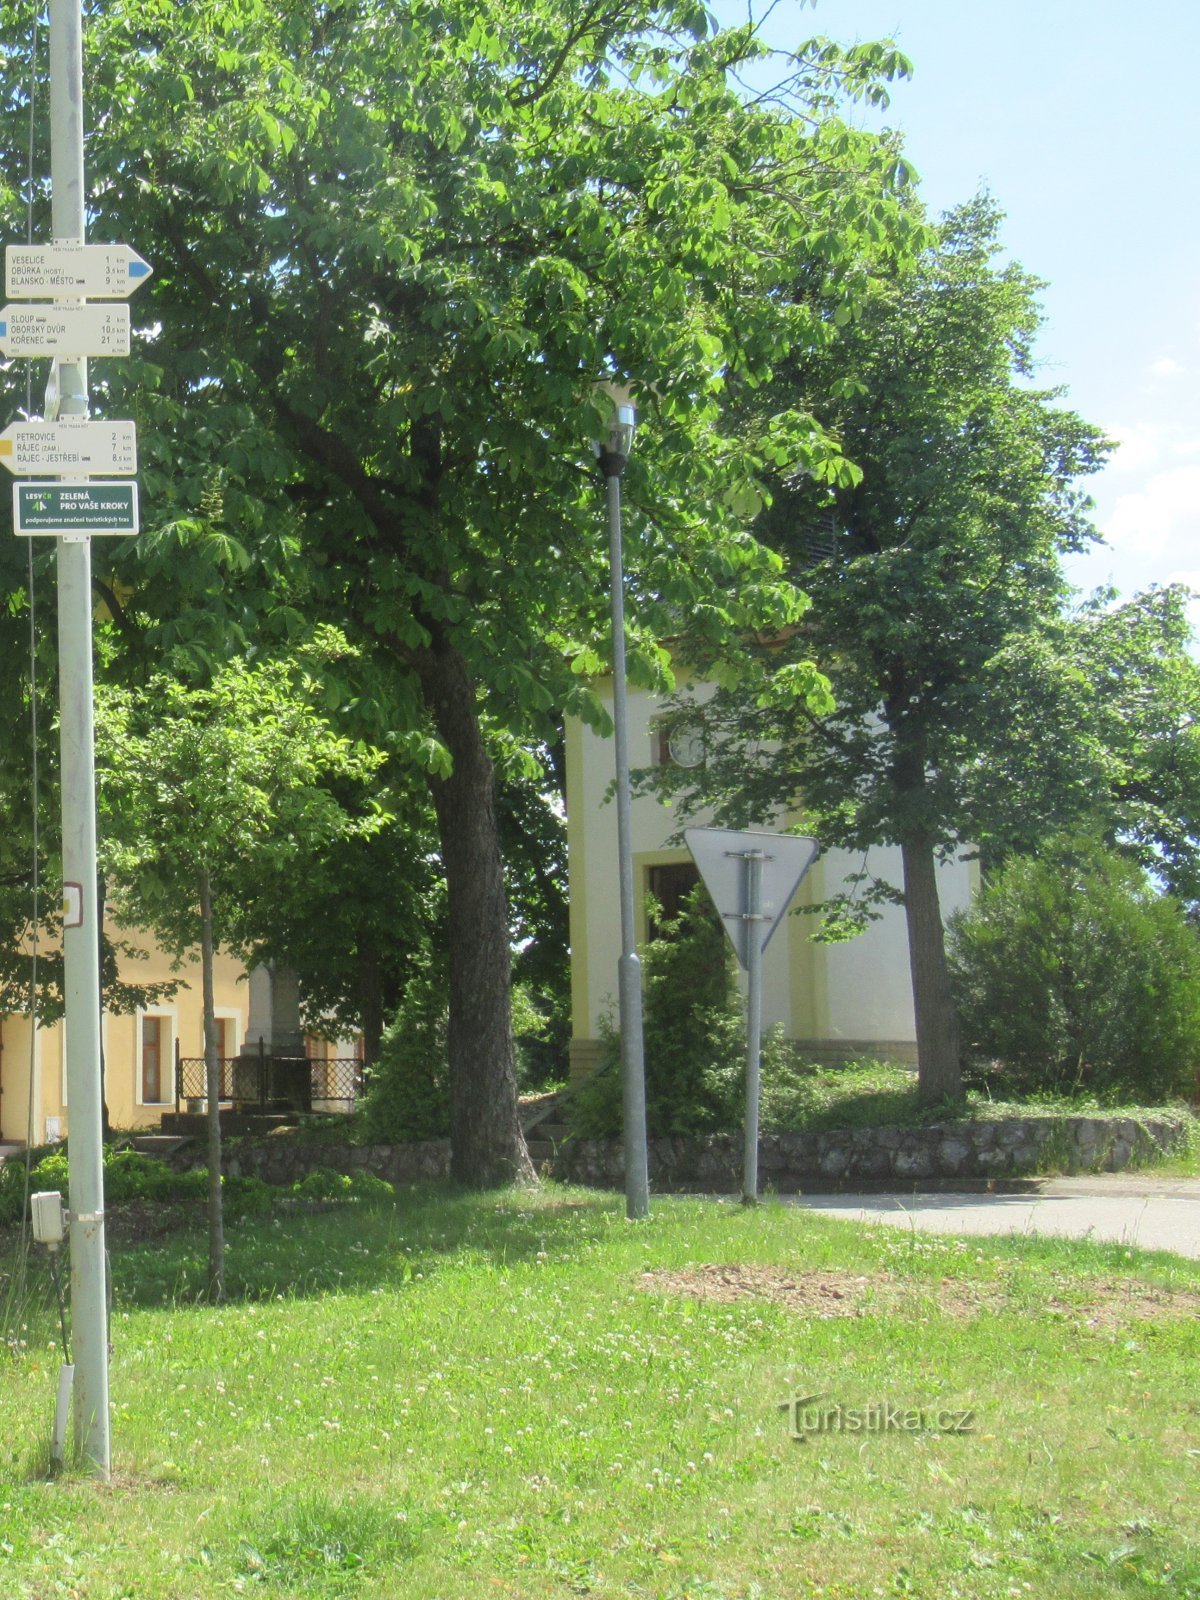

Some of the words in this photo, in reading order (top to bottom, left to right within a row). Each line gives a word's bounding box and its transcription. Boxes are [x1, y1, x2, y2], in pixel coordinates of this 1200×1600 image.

[11, 256, 45, 264] VESELICE
[11, 277, 45, 285] BLANSKO
[10, 315, 34, 323] SLOUP
[10, 324, 45, 333] OBORSKÝ
[10, 335, 45, 344] KOŘENEC
[101, 335, 110, 344] 21
[16, 433, 56, 441] PETROVICE
[111, 432, 117, 441] 2
[16, 443, 40, 452] RÁJEC
[111, 443, 117, 451] 7
[17, 453, 40, 462] RÁJEC
[46, 452, 80, 462] JESTŘEBÍ
[60, 490, 90, 500] ZELENÁ
[60, 502, 77, 510] PRO
[78, 501, 99, 510] VAŠE
[100, 502, 129, 510] KROKY
[25, 516, 63, 525] podporujeme
[85, 516, 118, 524] turistických
